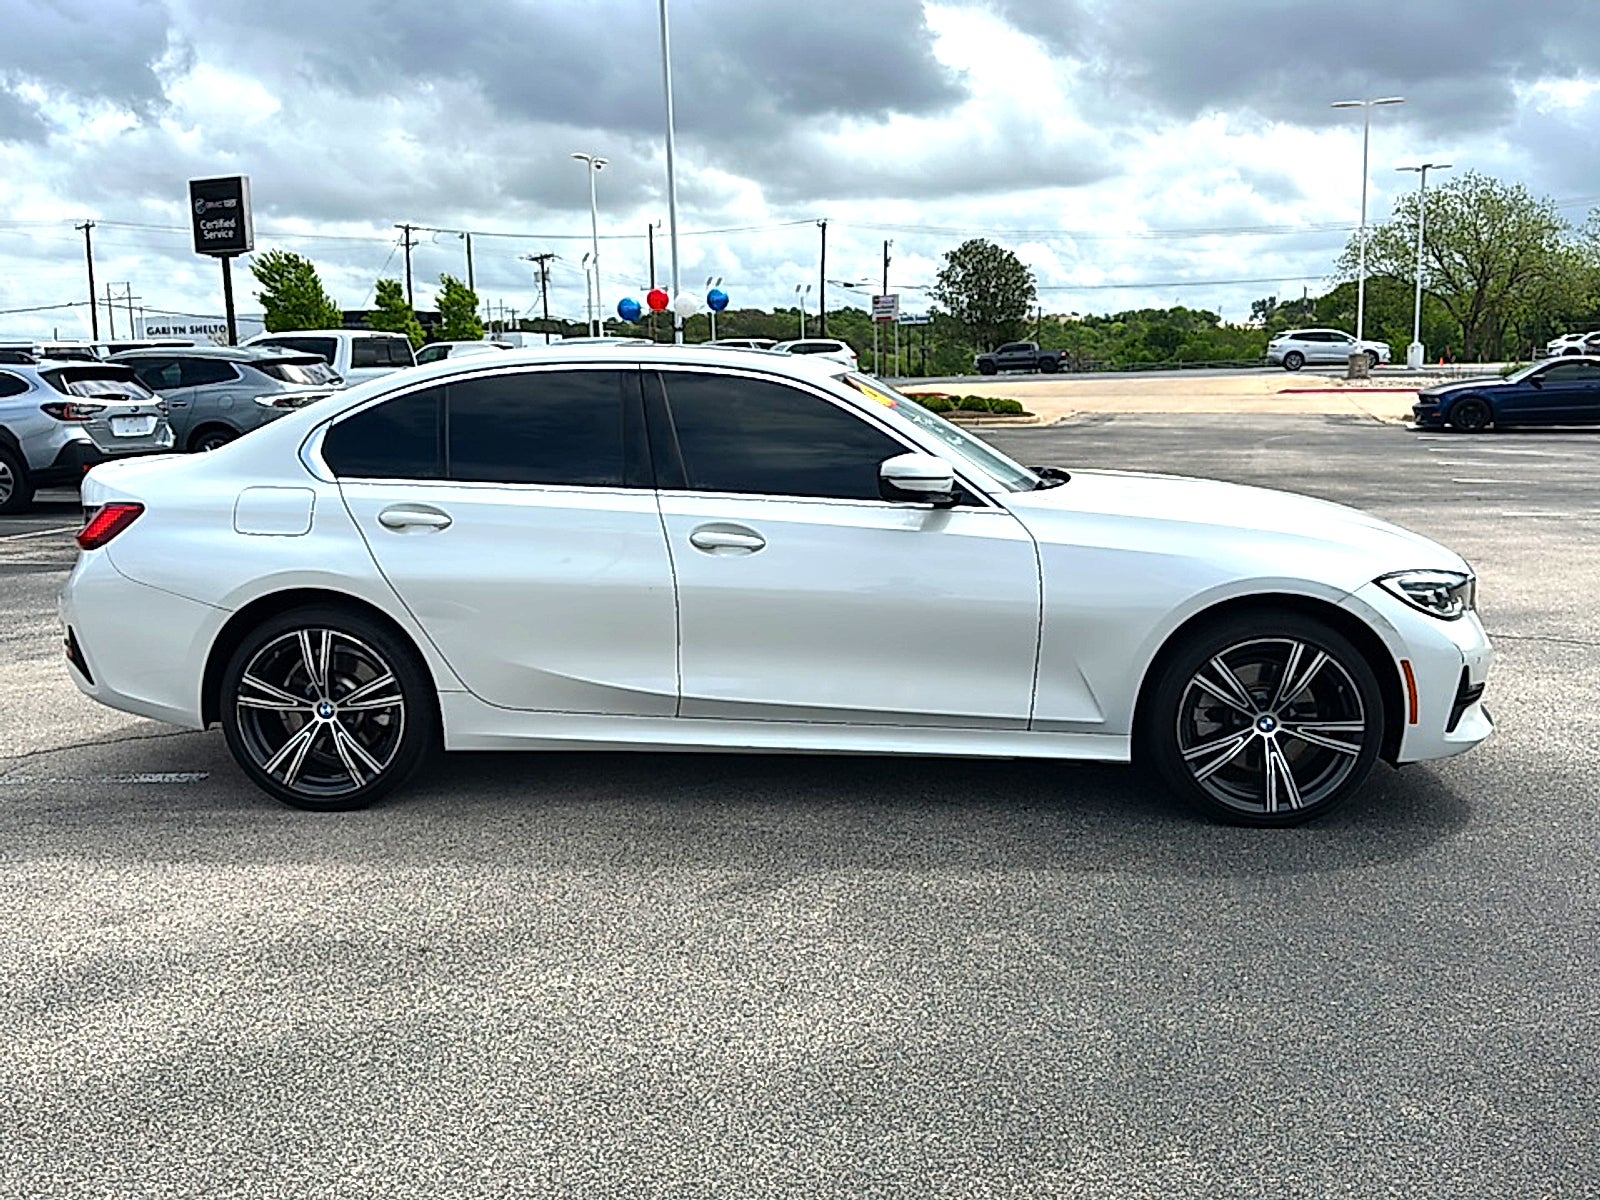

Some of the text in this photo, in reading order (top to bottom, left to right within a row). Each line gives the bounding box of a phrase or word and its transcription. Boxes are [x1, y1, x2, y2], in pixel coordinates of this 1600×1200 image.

[200, 217, 236, 230] Certified
[203, 229, 234, 239] Service
[189, 324, 227, 335] SHELTO
